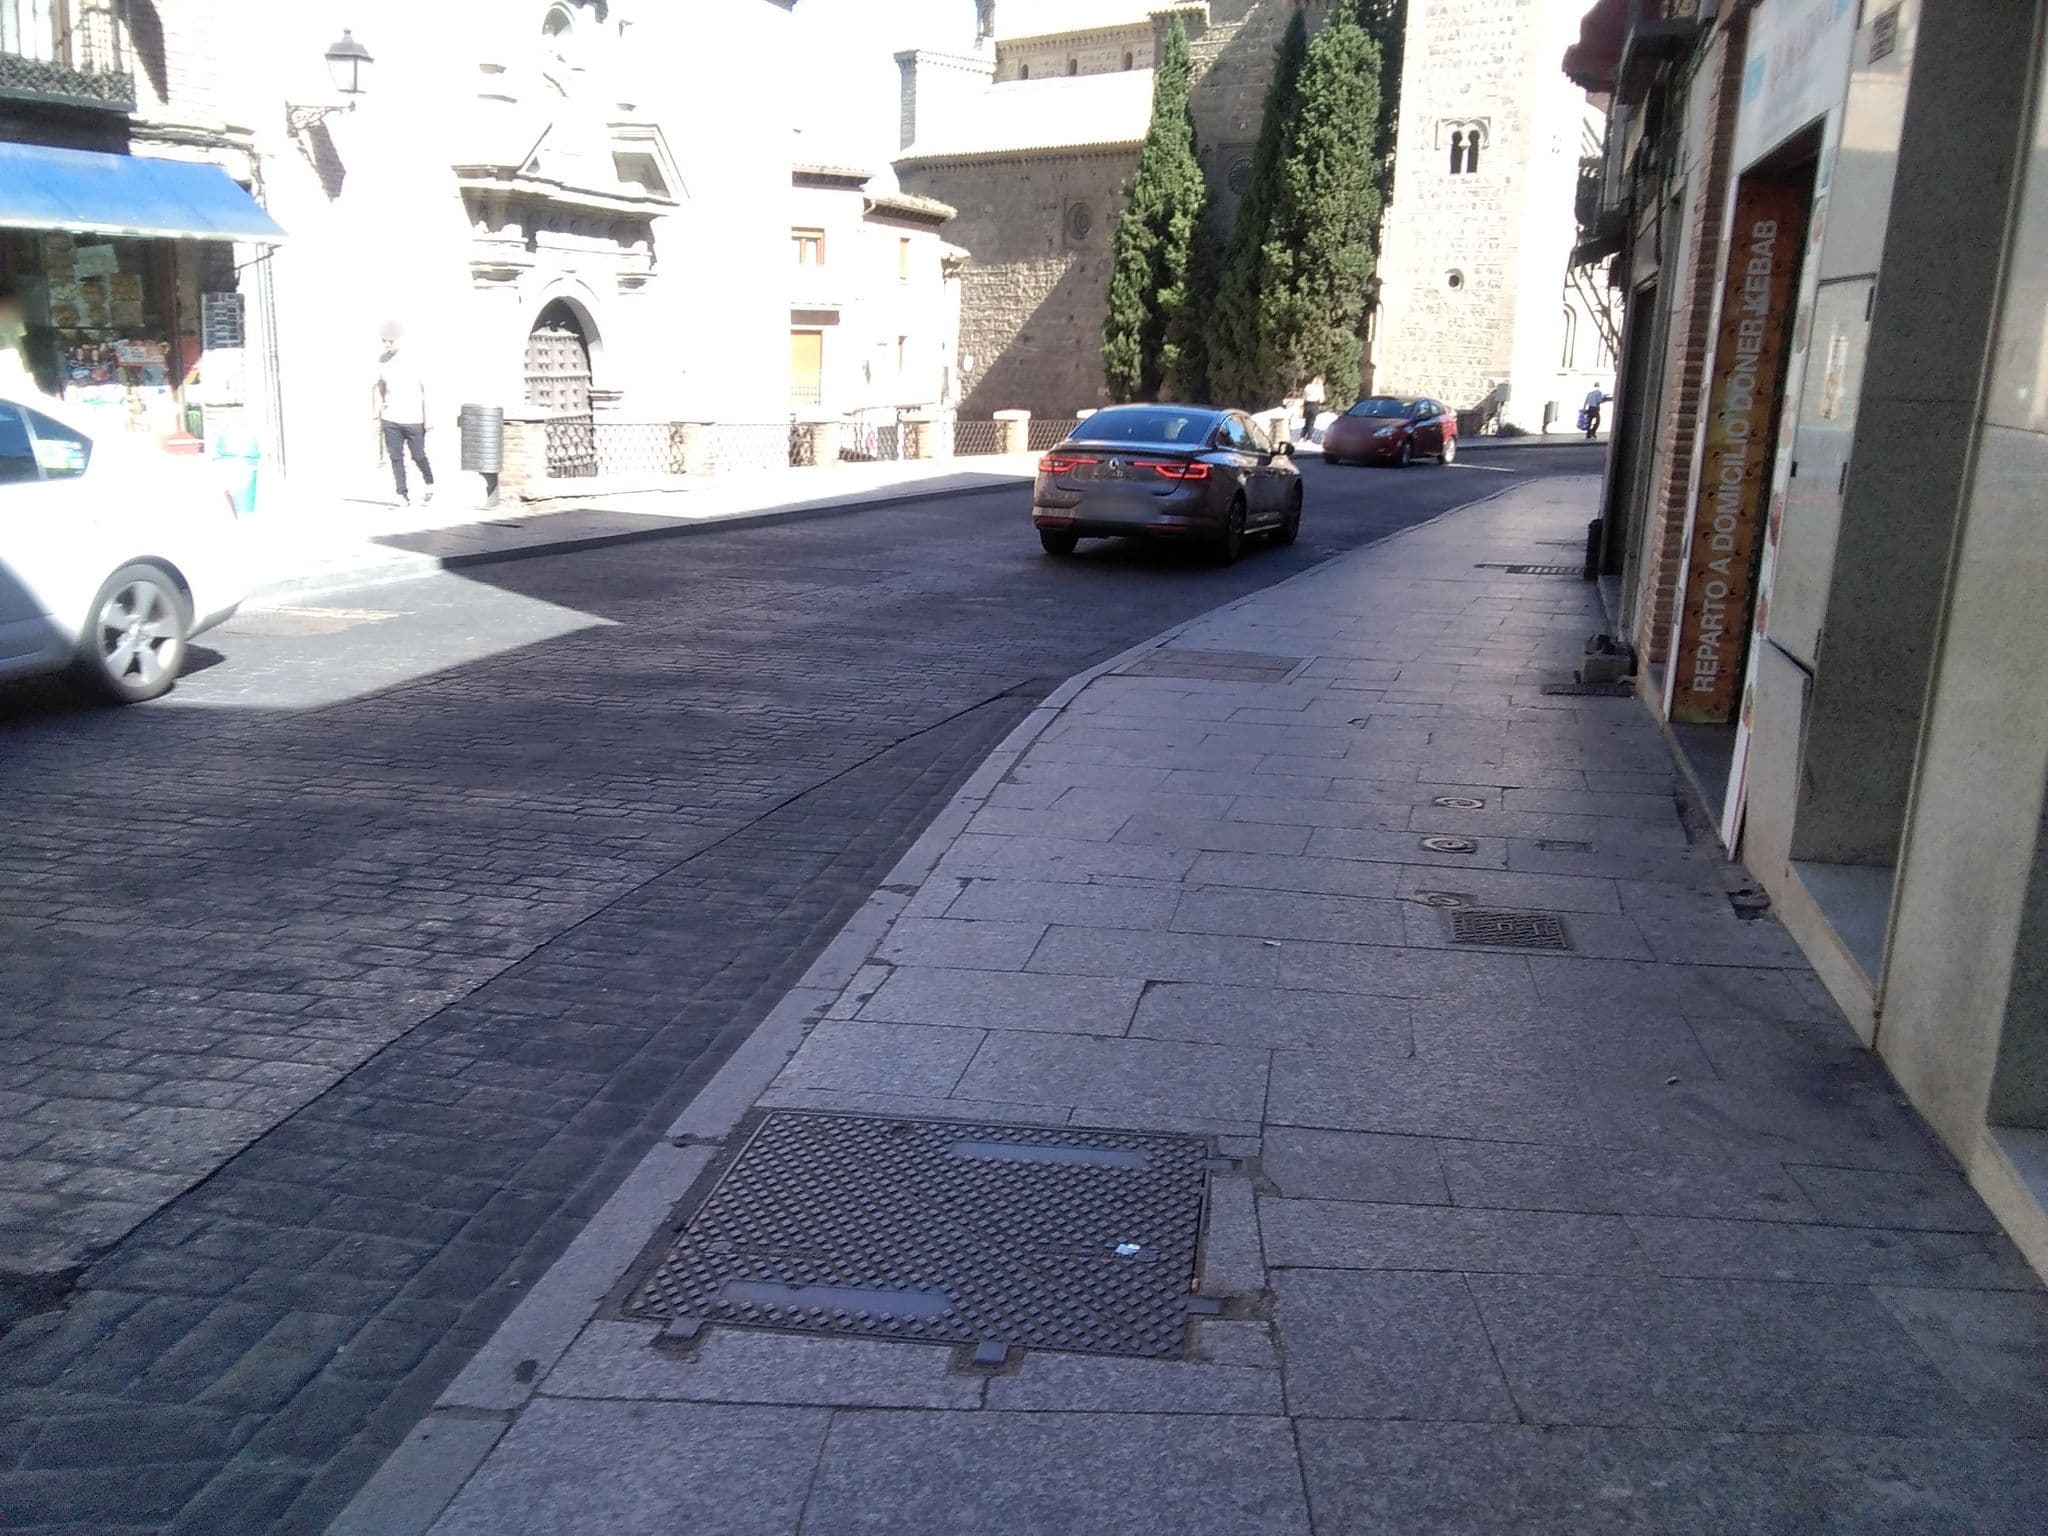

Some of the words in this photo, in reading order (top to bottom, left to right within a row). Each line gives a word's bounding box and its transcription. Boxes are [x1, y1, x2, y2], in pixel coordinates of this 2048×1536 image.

[1743, 220, 1777, 317] KEBAB
[1711, 416, 1751, 551] DOMICILIO
[1708, 558, 1731, 575] A
[1693, 579, 1729, 693] REPARTO
